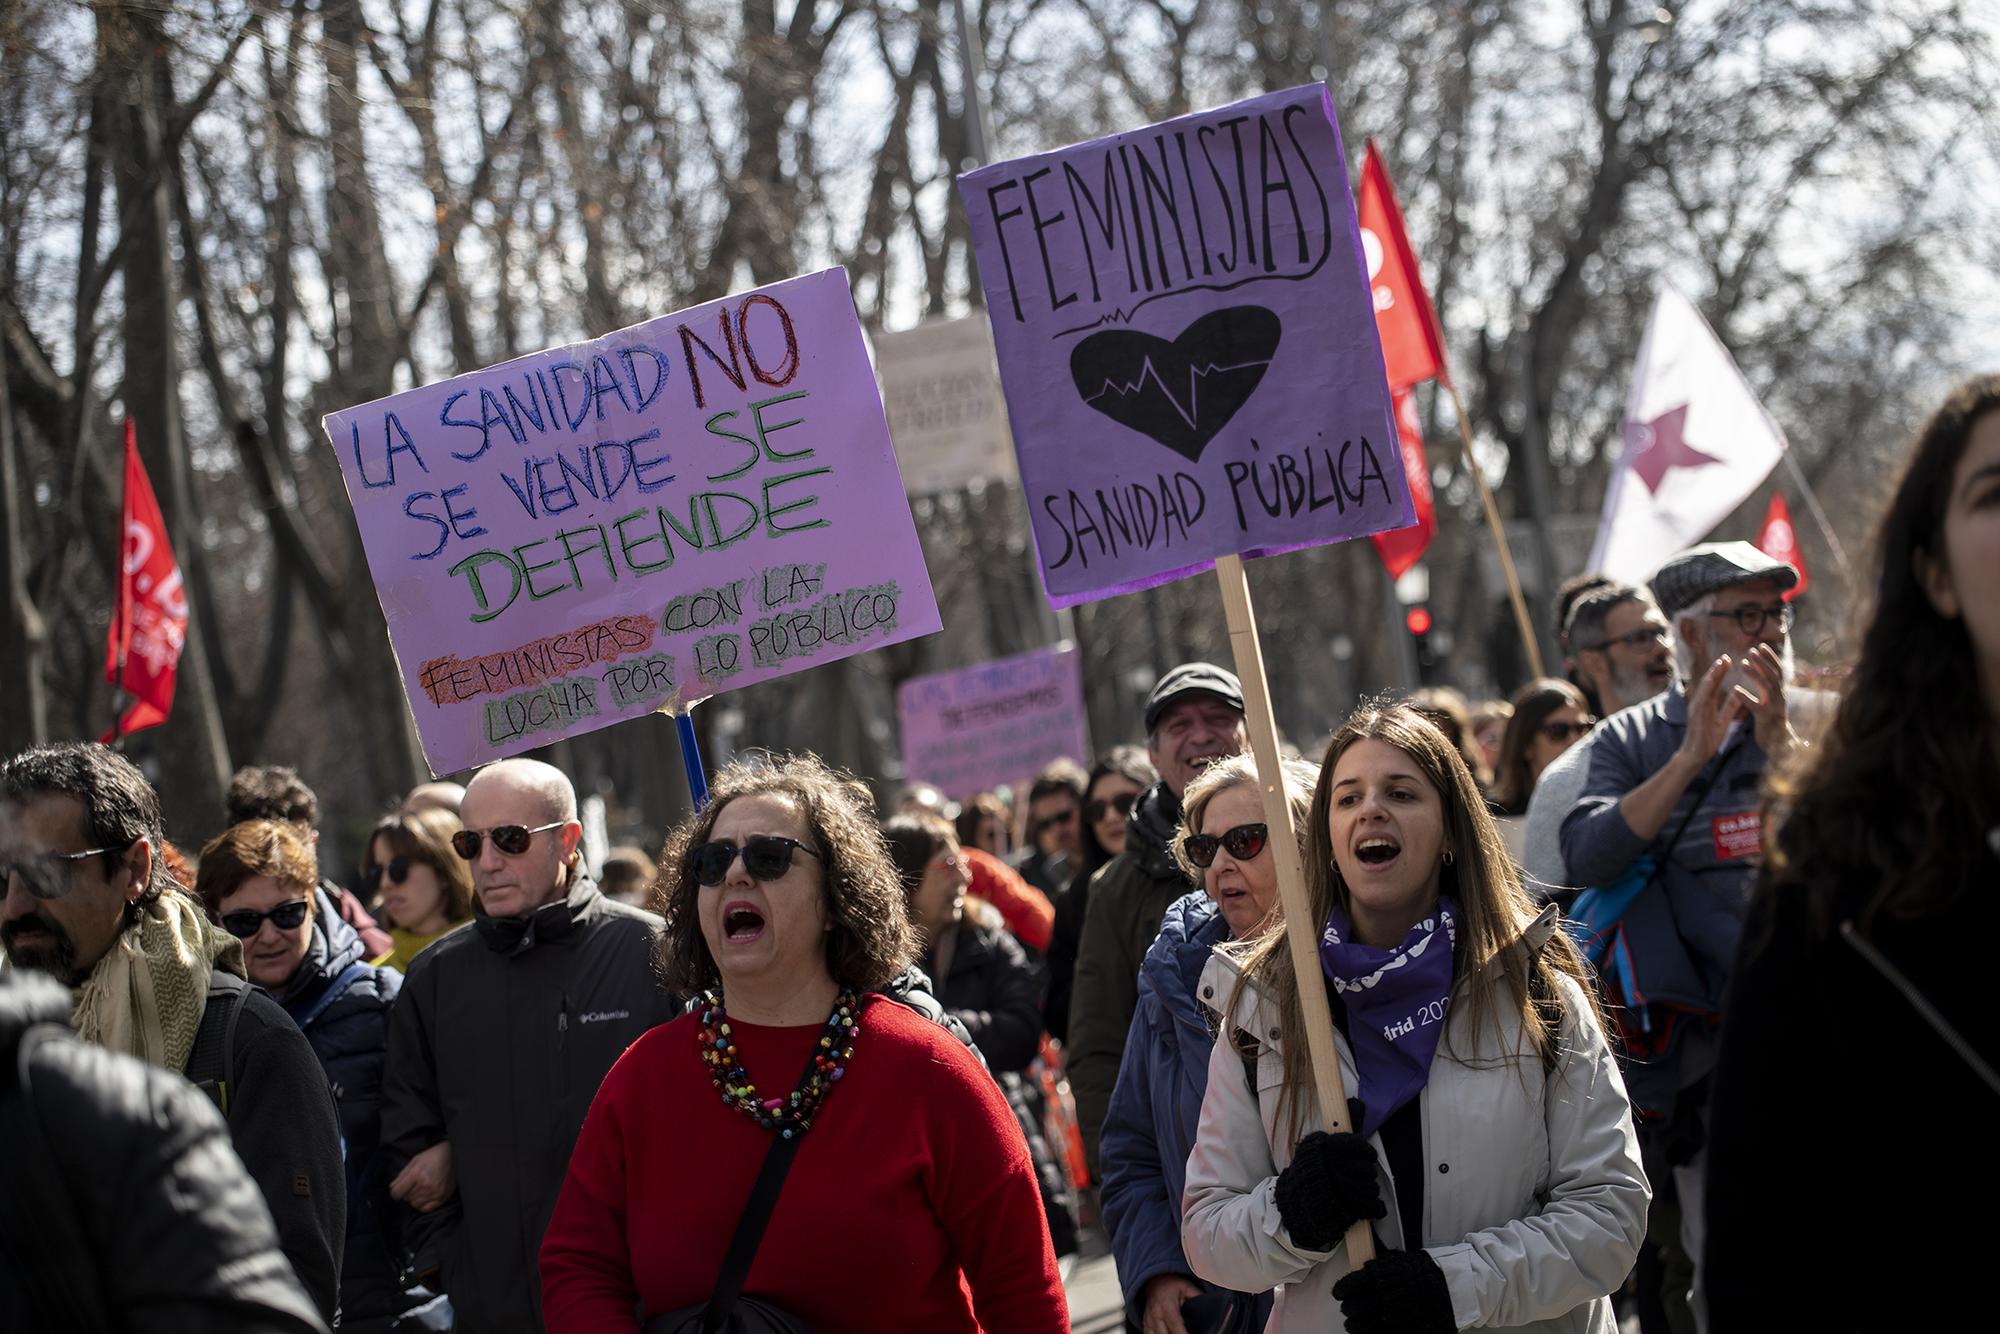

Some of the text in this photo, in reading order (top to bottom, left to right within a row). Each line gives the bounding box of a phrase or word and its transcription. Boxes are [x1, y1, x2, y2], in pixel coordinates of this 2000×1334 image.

[988, 104, 1332, 323] FEMINISTAS
[352, 294, 800, 488] LA SANIDAD NO
[402, 390, 816, 560] SE VENDE SE
[448, 466, 833, 624] DEFIENDE
[1044, 472, 1205, 570] SANIDAD
[419, 566, 821, 709] FEMINISTAS CON LA
[487, 592, 896, 742] LUCHA POR LO PÚBLICO
[588, 1009, 629, 1022] Columbia
[1383, 1016, 1415, 1042] drid
